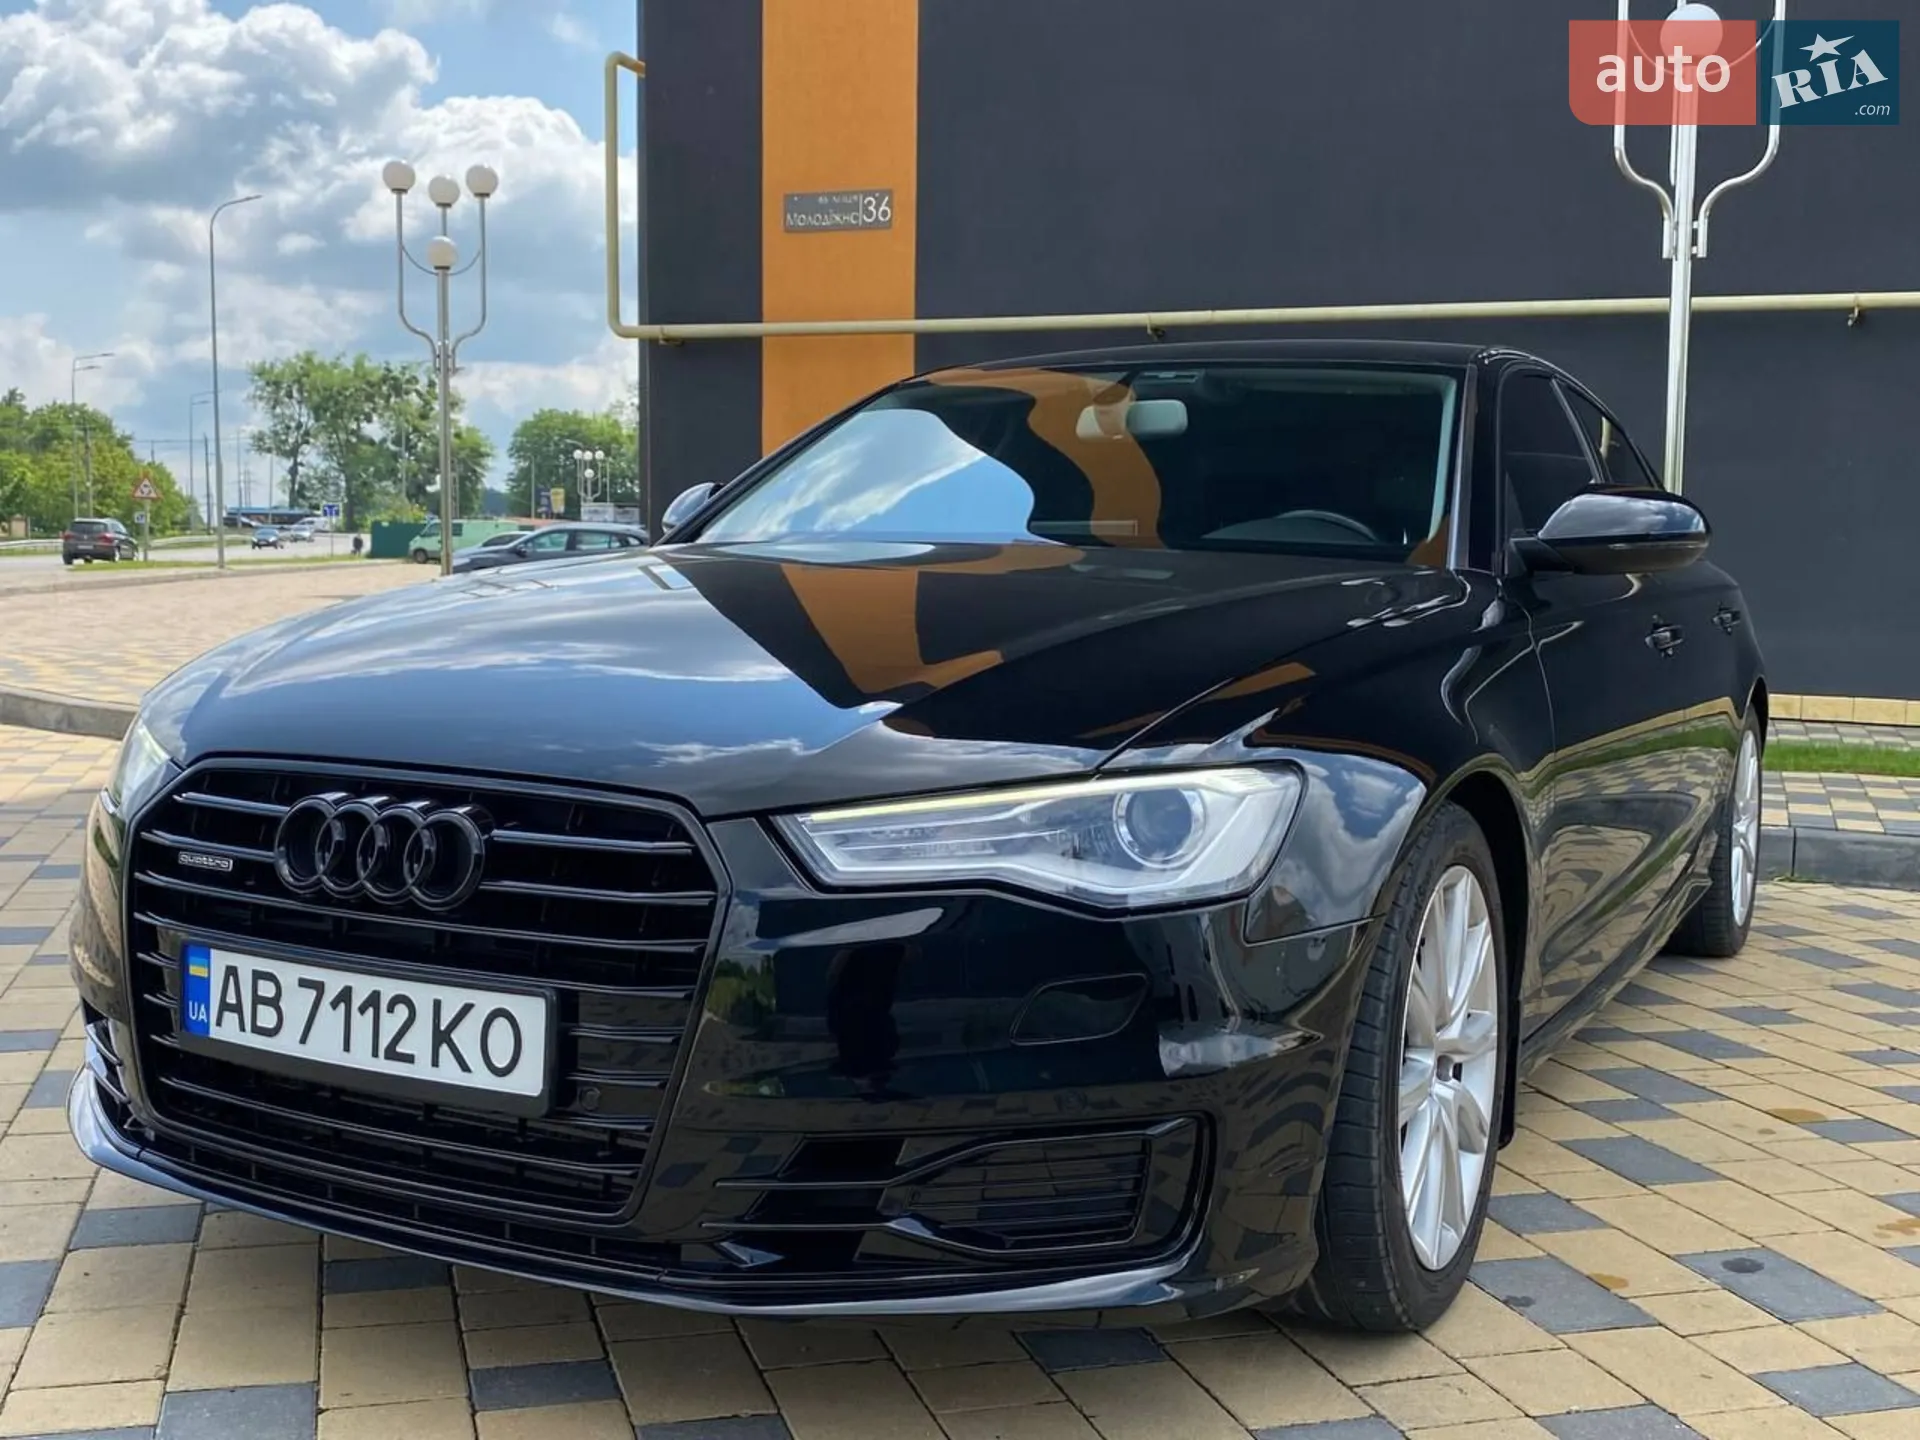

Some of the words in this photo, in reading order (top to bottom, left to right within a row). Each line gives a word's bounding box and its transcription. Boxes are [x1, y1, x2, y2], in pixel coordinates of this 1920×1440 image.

[863, 196, 891, 222] 36
[189, 1002, 208, 1022] UA
[215, 965, 284, 1037] AB
[297, 977, 416, 1064] 7112
[430, 999, 523, 1078] KO
